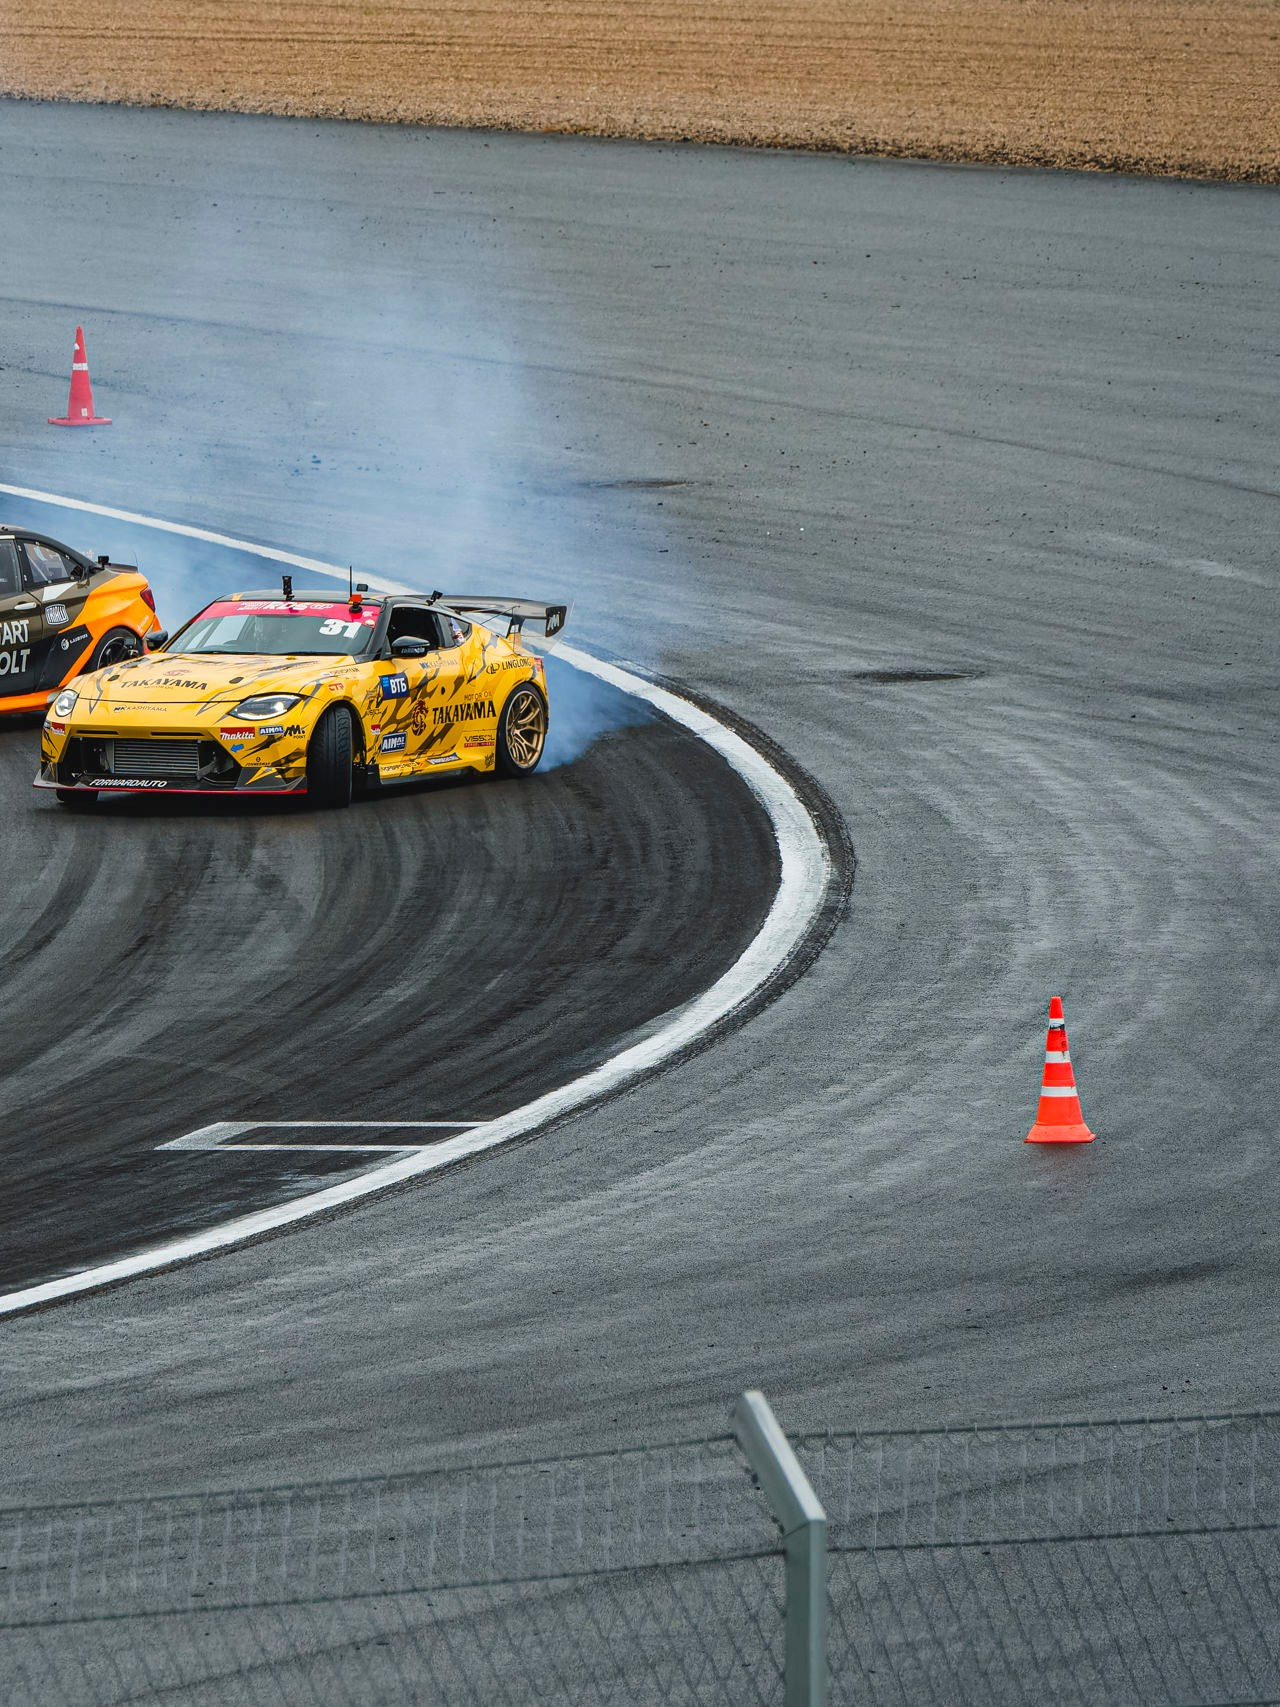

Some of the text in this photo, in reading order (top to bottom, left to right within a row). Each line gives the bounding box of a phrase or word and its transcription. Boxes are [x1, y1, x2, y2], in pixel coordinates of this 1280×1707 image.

[263, 601, 312, 610] RDS
[319, 618, 362, 639] 31
[501, 657, 532, 671] LINGLONG
[120, 678, 208, 690] TAKAYAMA
[389, 677, 408, 694] ВТБ
[464, 693, 482, 701] MOTOR
[432, 700, 497, 724] TAKAYAMA
[381, 736, 406, 751] AIMOL
[89, 778, 168, 788] FORWARDAUTO
